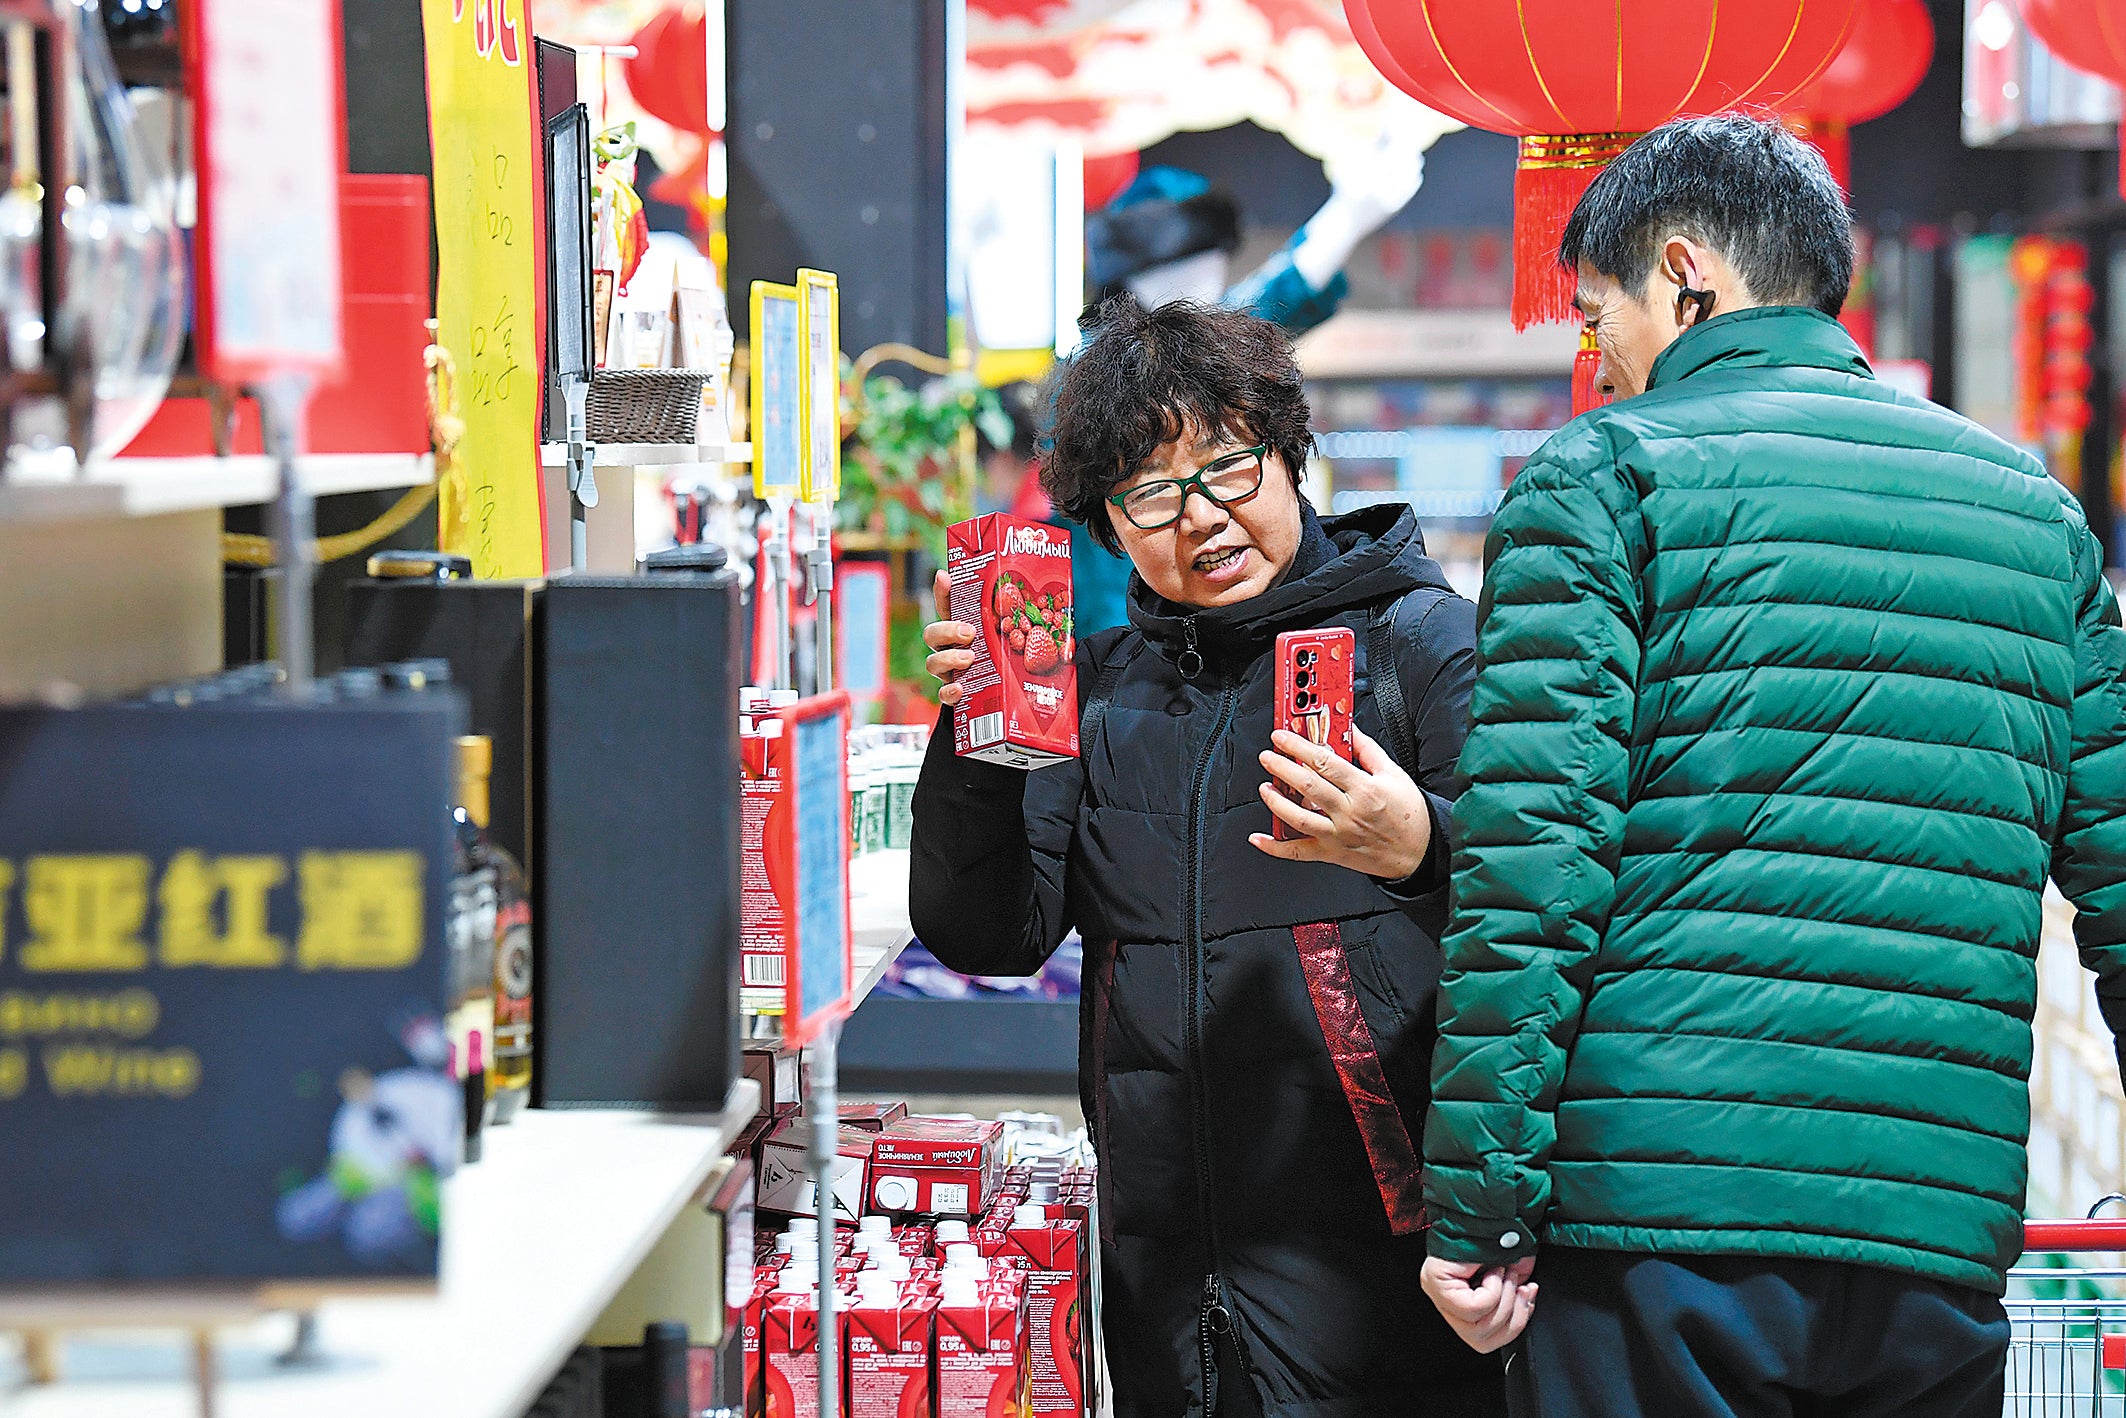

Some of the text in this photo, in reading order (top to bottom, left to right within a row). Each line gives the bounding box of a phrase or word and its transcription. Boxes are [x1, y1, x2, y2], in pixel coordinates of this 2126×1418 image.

[1000, 525, 1071, 558] Любимый
[0, 848, 426, 973] 亚红酒
[878, 1144, 895, 1152] ЛЕТО
[932, 1147, 977, 1164] Любимый
